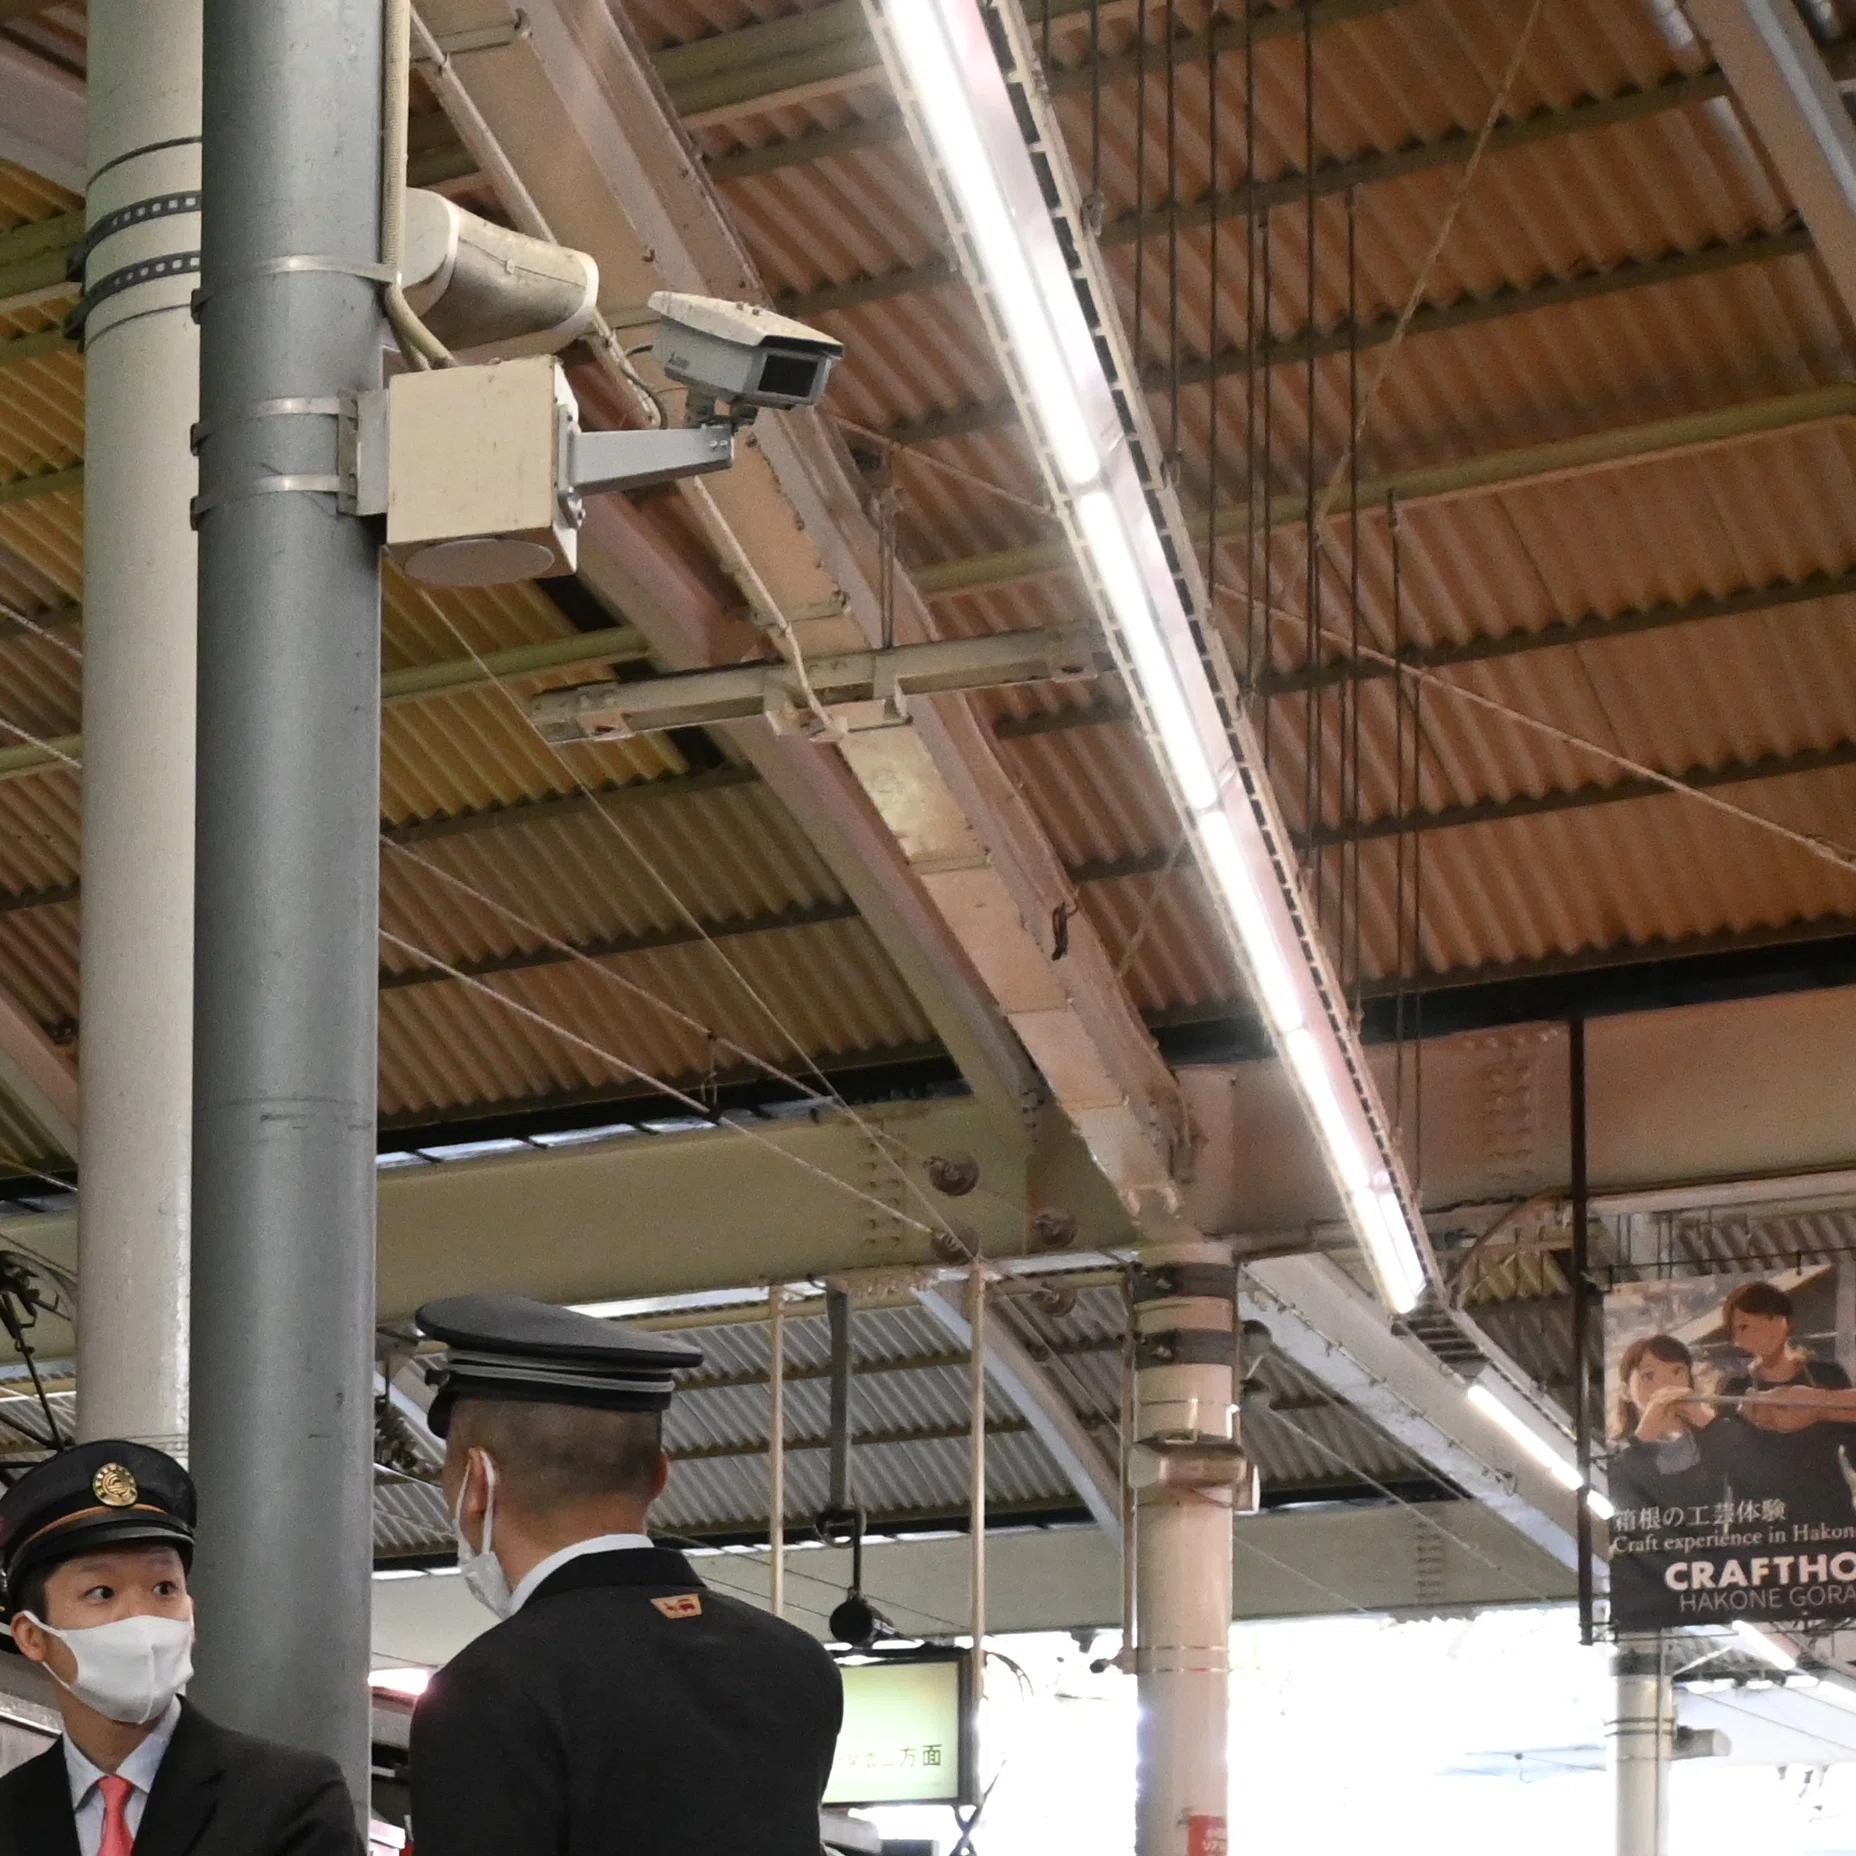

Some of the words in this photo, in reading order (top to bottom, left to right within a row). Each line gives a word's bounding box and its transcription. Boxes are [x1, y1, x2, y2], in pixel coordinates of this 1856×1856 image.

[1614, 1497, 1788, 1532] 箱根の工芸体験
[1613, 1534, 1660, 1554] Craft
[1663, 1527, 1763, 1554] experience
[1768, 1525, 1787, 1543] in
[1664, 1551, 1856, 1592] CRAFTHO
[1679, 1587, 1783, 1613] HAKONE
[1788, 1583, 1856, 1606] GORA
